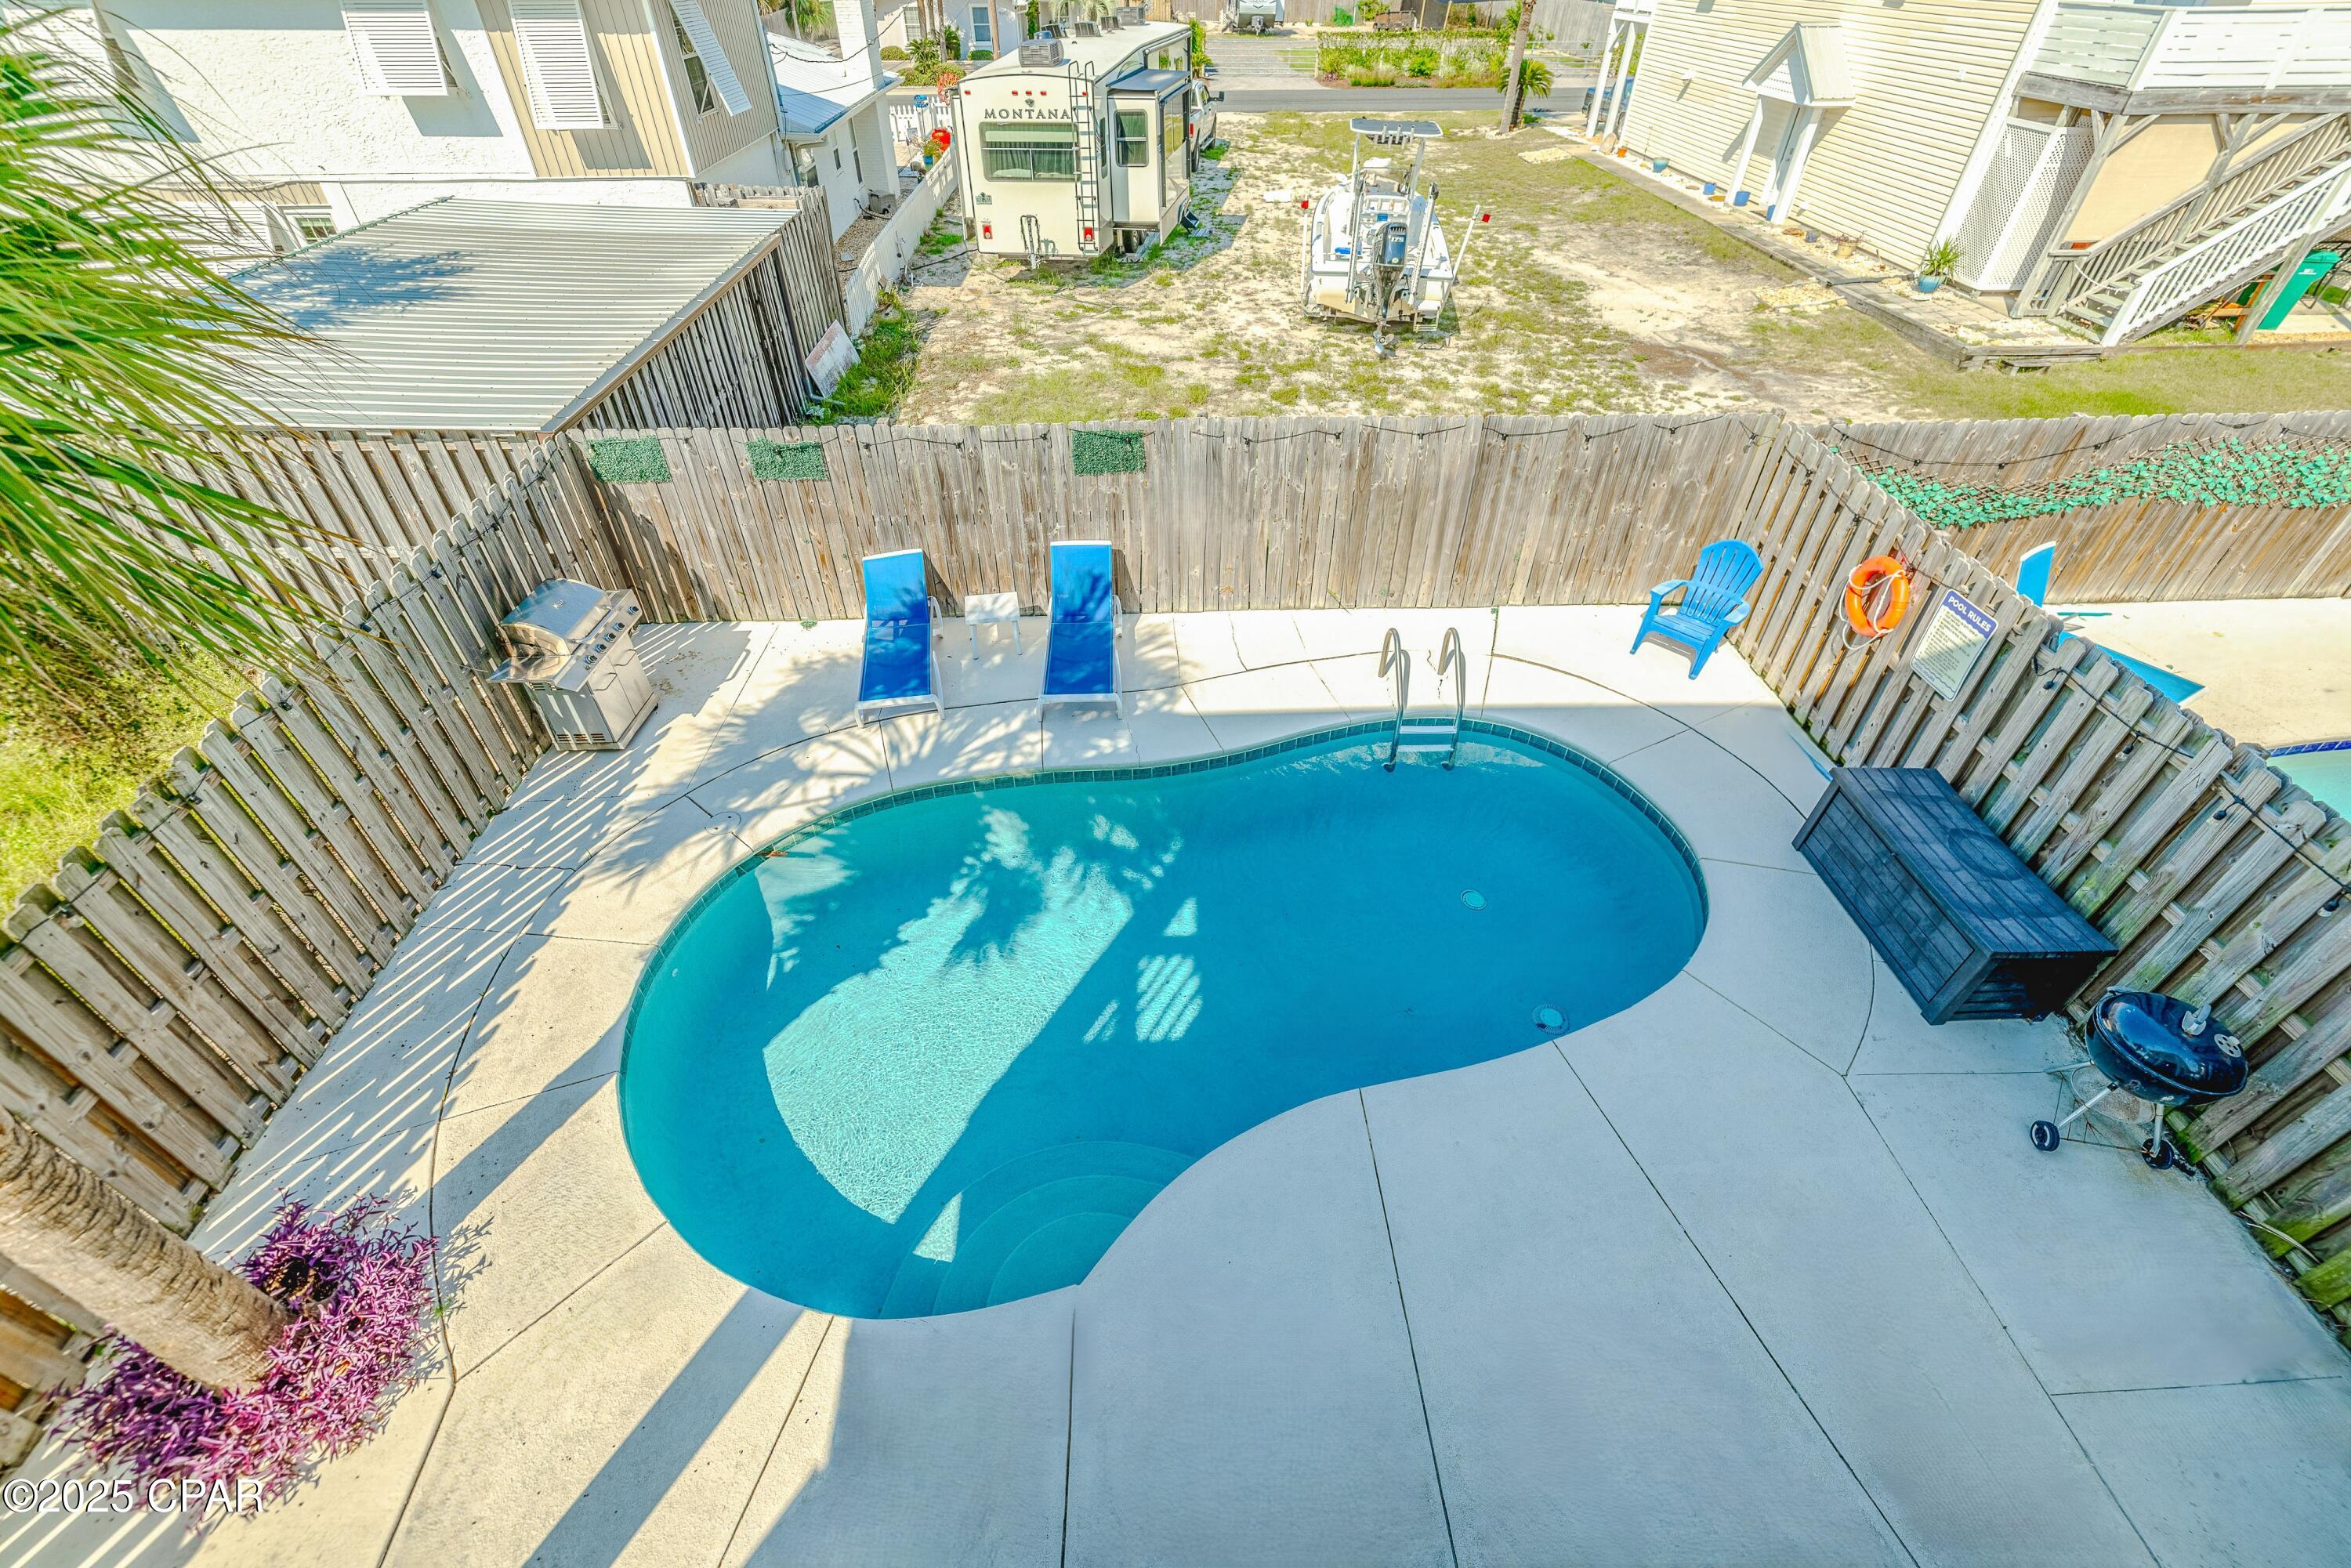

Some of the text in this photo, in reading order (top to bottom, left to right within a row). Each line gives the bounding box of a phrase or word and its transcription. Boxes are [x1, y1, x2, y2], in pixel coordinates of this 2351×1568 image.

[984, 108, 1071, 119] MONTANA
[1948, 596, 1991, 632] POOL RULES
